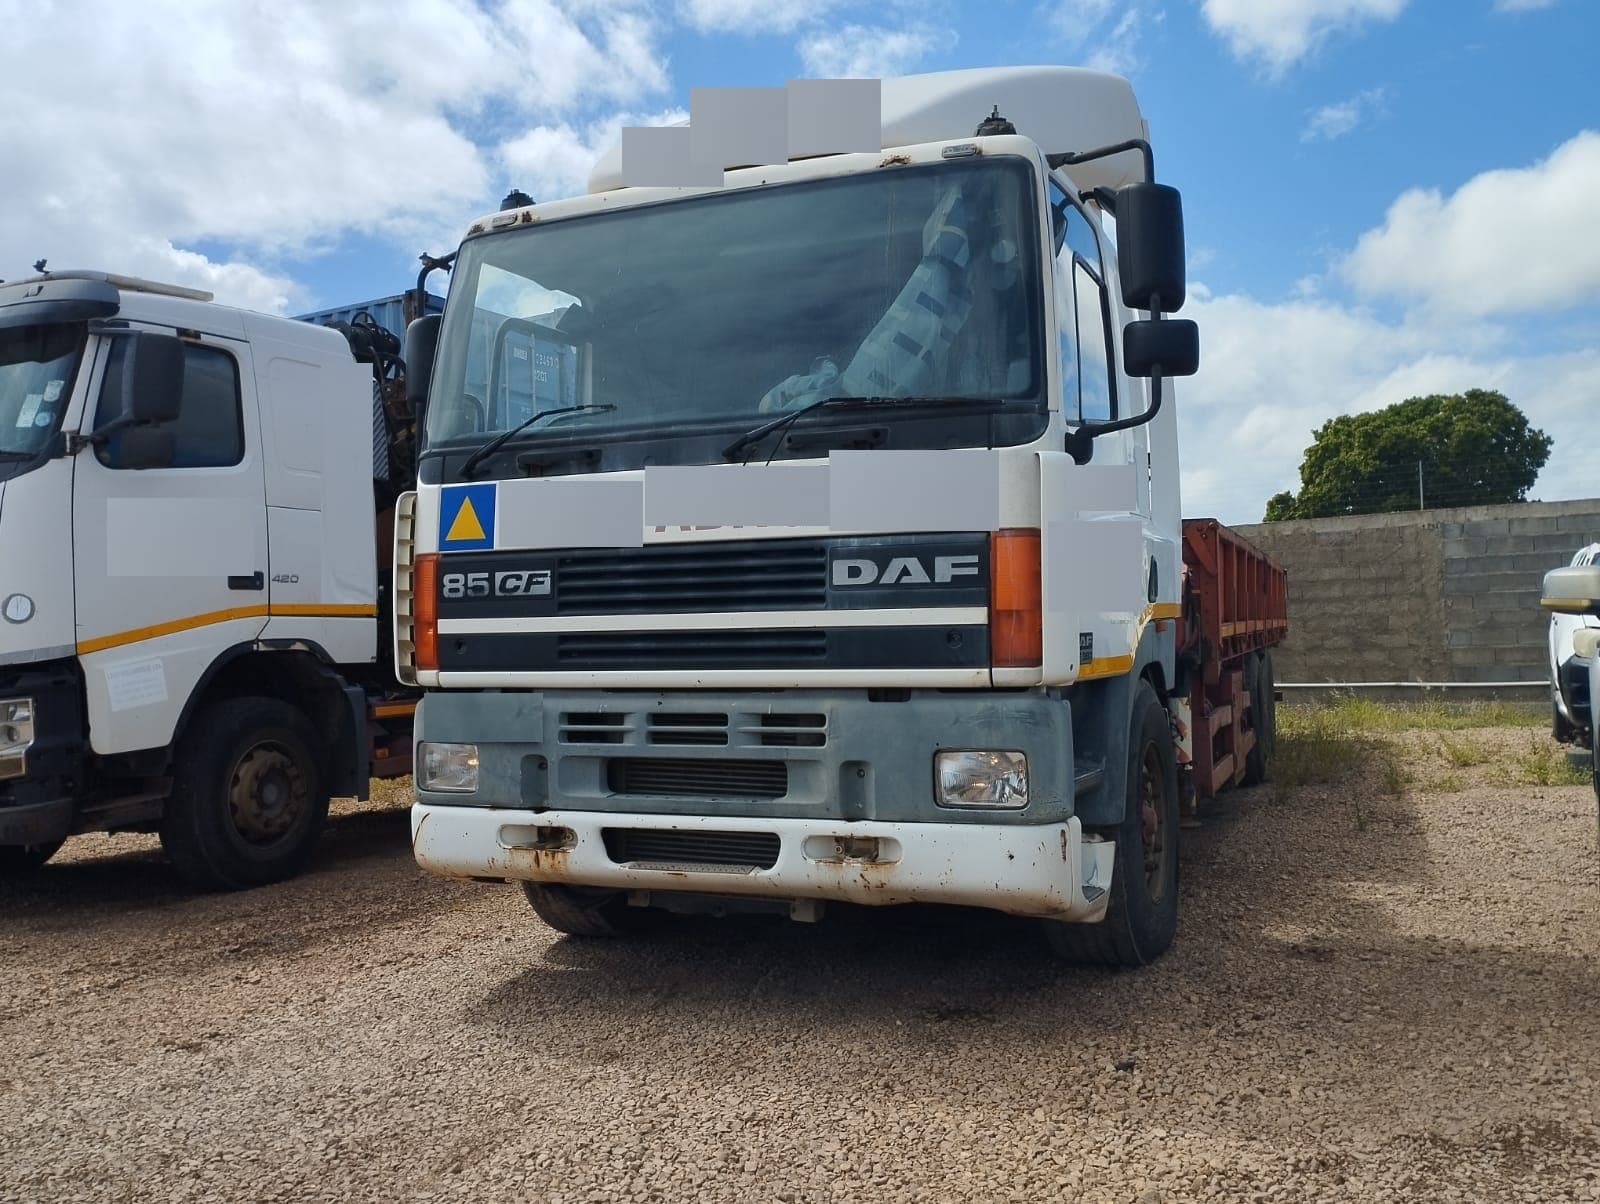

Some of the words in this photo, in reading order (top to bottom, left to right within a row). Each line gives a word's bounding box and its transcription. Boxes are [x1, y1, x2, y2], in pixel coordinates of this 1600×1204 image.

[271, 573, 300, 585] 420
[832, 554, 979, 586] DAF
[442, 572, 490, 598] 85
[498, 572, 550, 595] CF
[1080, 634, 1092, 647] AF
